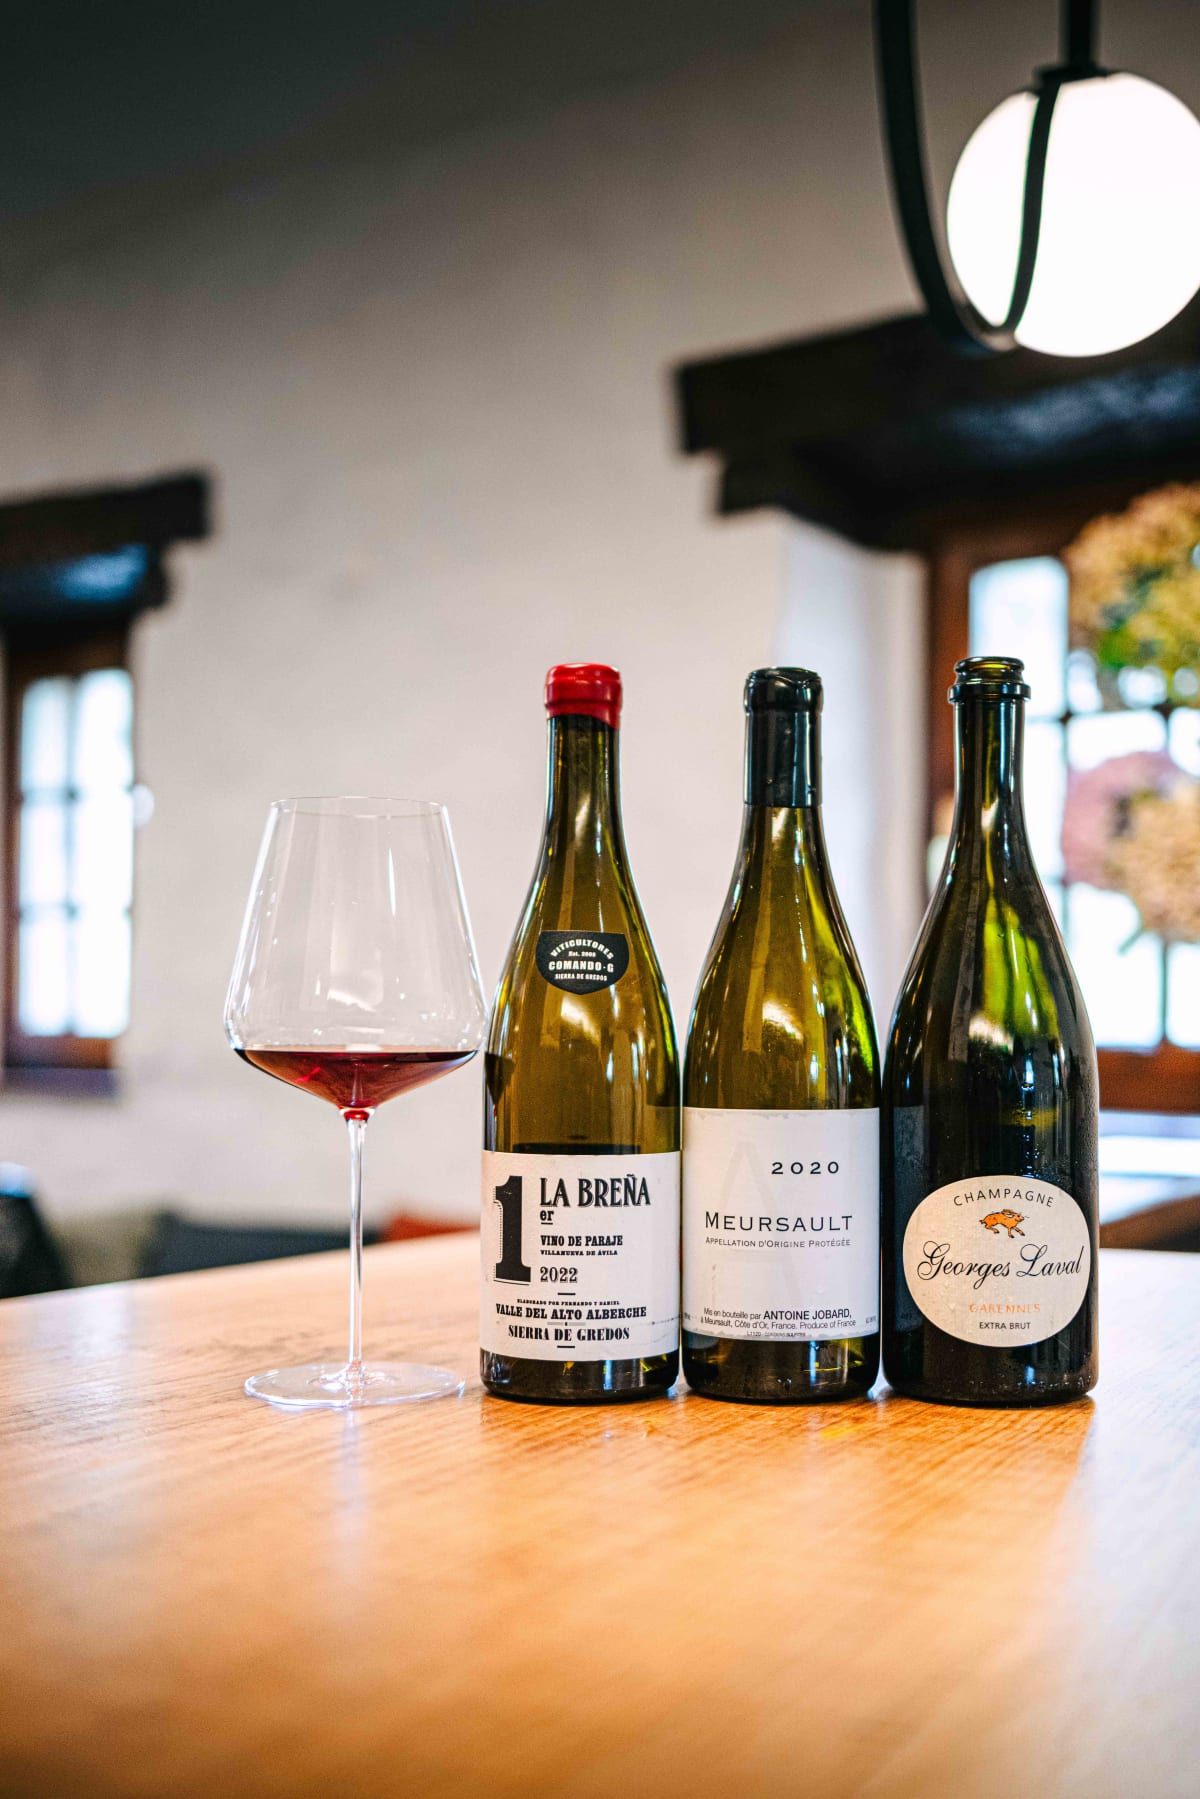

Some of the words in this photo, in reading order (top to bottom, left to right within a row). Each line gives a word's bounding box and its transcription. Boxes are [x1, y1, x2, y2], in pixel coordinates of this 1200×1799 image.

[549, 939, 615, 960] VITICULTORES
[585, 974, 608, 982] GREDOS
[771, 1161, 840, 1175] 2020
[540, 1177, 571, 1208] LA
[578, 1174, 652, 1208] BREÑA
[953, 1188, 1055, 1208] CHAMPAGNE
[705, 1211, 853, 1232] MEURSAULT
[494, 1175, 531, 1286] 1
[540, 1235, 565, 1247] VINO
[568, 1235, 582, 1247] DE
[585, 1235, 624, 1247] PARAJE
[705, 1237, 756, 1247] APPELLATION
[917, 1240, 1010, 1290] Georges
[1016, 1243, 1085, 1278] Laval
[540, 1267, 579, 1284] 2022
[517, 1298, 547, 1306] ELABORADO
[968, 1303, 1042, 1314] GARENNES
[495, 1303, 523, 1318] VALLE
[526, 1306, 548, 1319] DEL
[550, 1309, 583, 1321] ALTO
[586, 1306, 647, 1320] ALBERCHE
[722, 1309, 749, 1320] bouteille
[750, 1313, 762, 1321] par
[763, 1310, 810, 1321] ANTOINE
[812, 1308, 852, 1320] JOBARD,
[799, 1321, 828, 1330] Produce
[837, 1319, 857, 1328] France
[979, 1321, 1007, 1330] EXTRA
[1009, 1321, 1032, 1330] BRUT
[508, 1325, 550, 1341] SIERRA
[554, 1328, 572, 1342] DE
[576, 1327, 630, 1342] GREDOS
